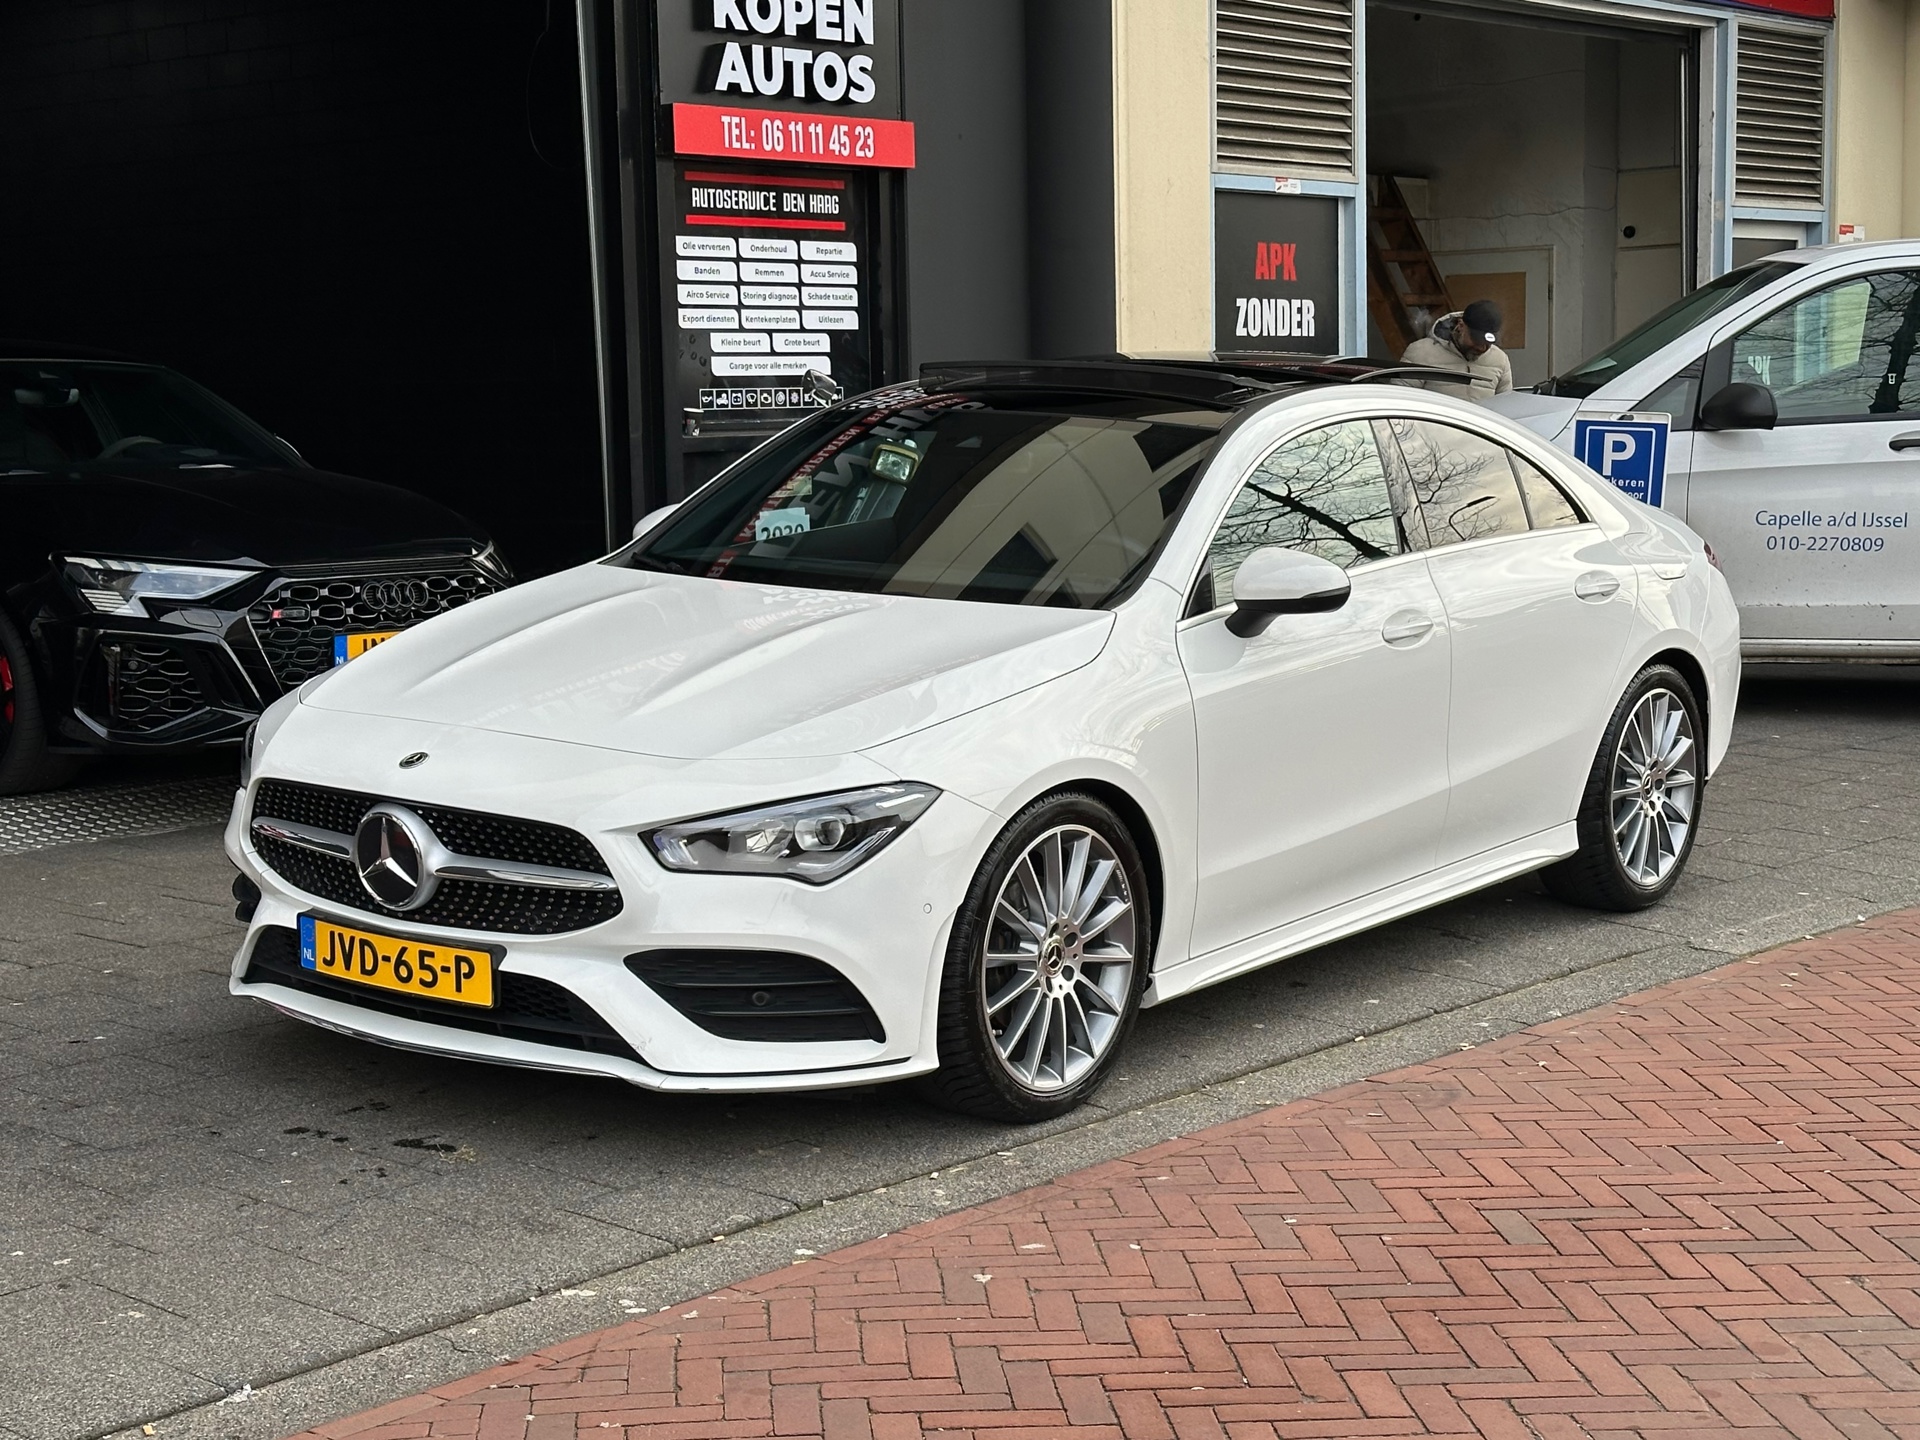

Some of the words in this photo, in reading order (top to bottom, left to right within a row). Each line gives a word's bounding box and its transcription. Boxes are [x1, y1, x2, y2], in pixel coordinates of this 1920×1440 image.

[713, 0, 875, 45] KOPEN
[715, 42, 876, 103] AUTOS
[721, 115, 756, 150] TEL:
[762, 118, 784, 153] 06
[788, 121, 804, 154] 11
[809, 123, 823, 155] 11
[829, 125, 850, 157] 45
[855, 126, 875, 158] 23
[691, 187, 777, 211] AUTOSERVICE
[783, 192, 805, 213] DEN
[809, 194, 839, 214] HAAG
[682, 241, 696, 250] Olie
[750, 244, 788, 253] Onderhoud
[1255, 242, 1297, 281] APK
[694, 266, 721, 275] Banden
[755, 268, 785, 277] Remmen
[810, 270, 826, 278] Accu
[827, 270, 850, 279] Service
[686, 290, 704, 298] Airco
[705, 290, 730, 299] Service
[743, 292, 766, 301] Storing
[768, 292, 798, 301] diagnose
[807, 292, 831, 301] Schade
[832, 293, 854, 301] taxatie
[682, 315, 705, 324] Export
[706, 315, 735, 323] diensten
[745, 315, 797, 324] Kentekenplaten
[818, 316, 844, 324] Uitlezen
[1235, 298, 1315, 337] ZONDER
[721, 338, 742, 346] Kleine
[743, 338, 761, 346] beurt
[784, 338, 802, 346] Grote
[729, 362, 753, 371] Garage
[770, 362, 782, 370] alle
[1602, 432, 1636, 476] P
[1605, 477, 1645, 487] keren
[1755, 510, 1822, 530] Capelle
[1827, 511, 1857, 528] a/d
[1862, 511, 1909, 528] IJssel
[1766, 535, 1885, 552] 010-2270809
[303, 947, 315, 962] NL
[321, 930, 476, 994] JVD-65-P
